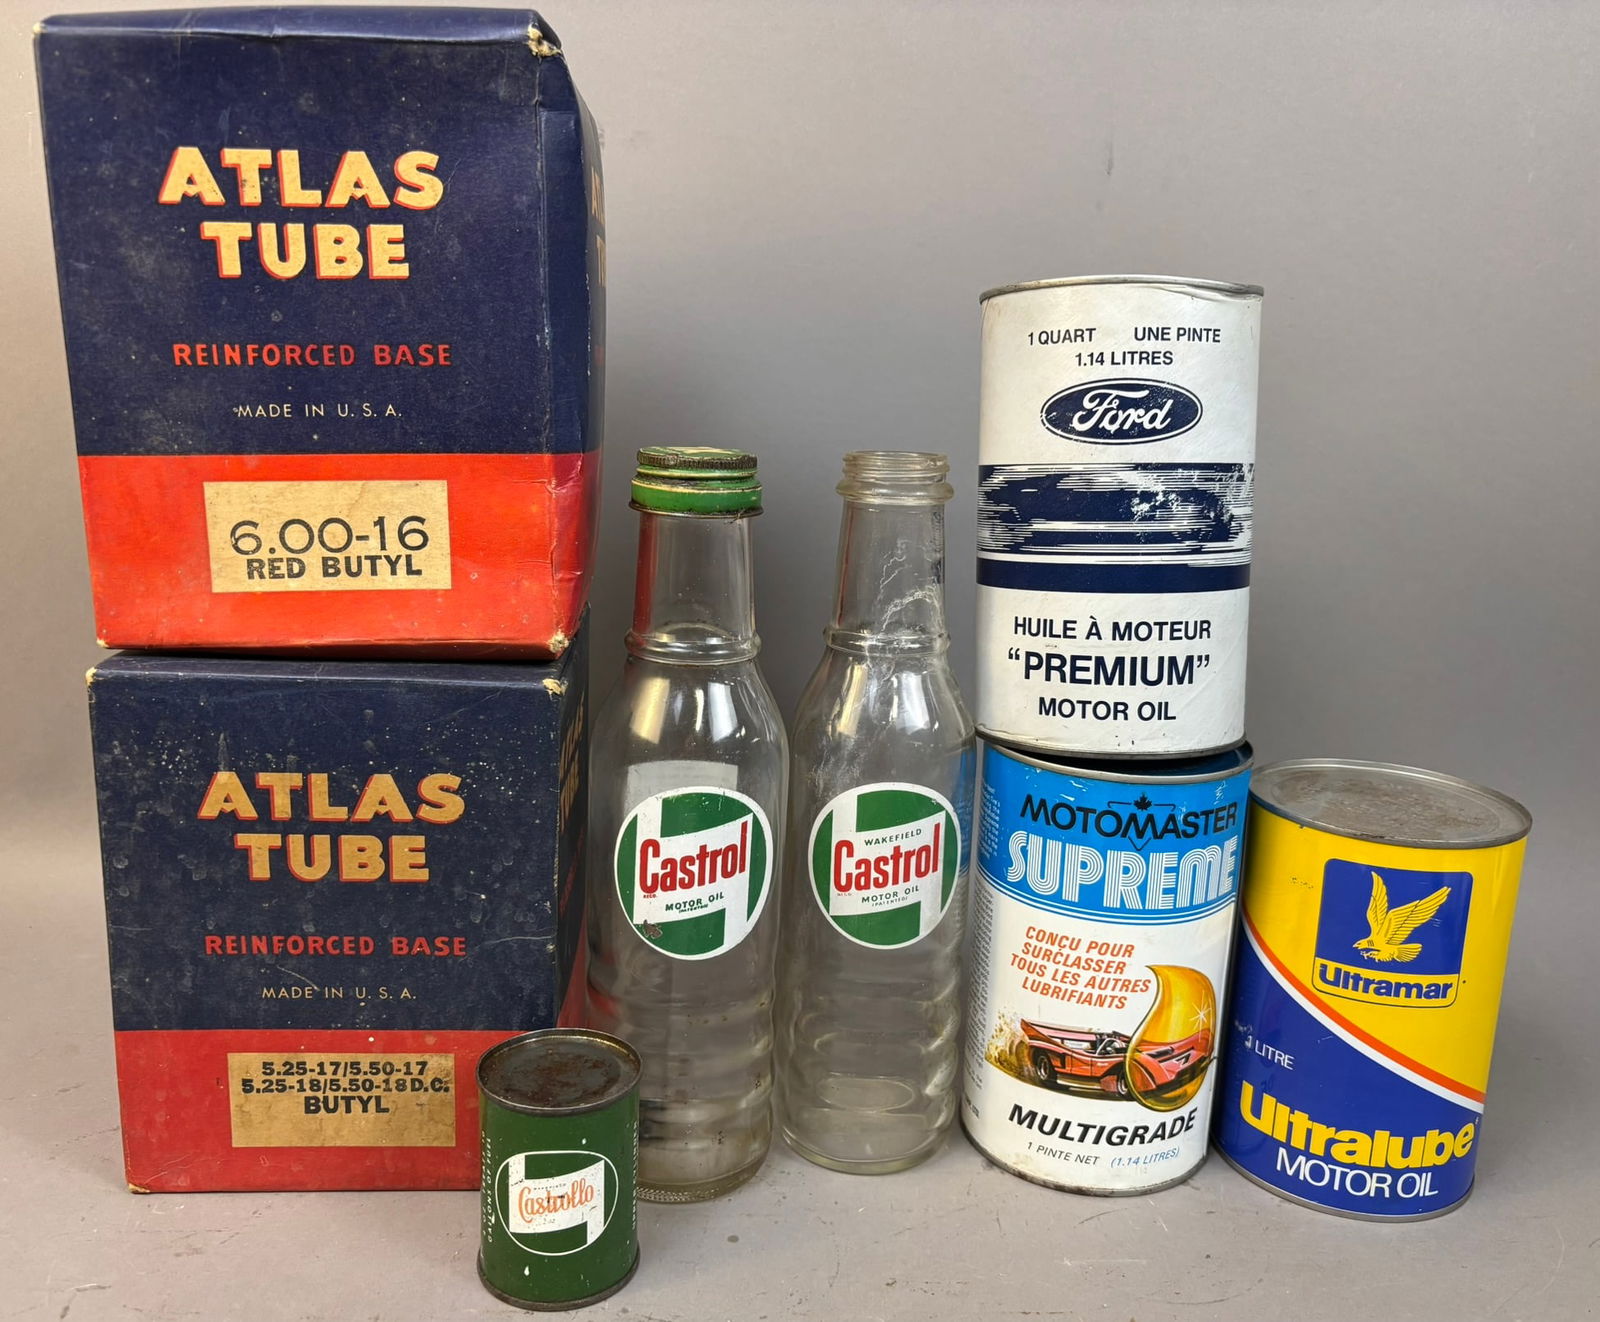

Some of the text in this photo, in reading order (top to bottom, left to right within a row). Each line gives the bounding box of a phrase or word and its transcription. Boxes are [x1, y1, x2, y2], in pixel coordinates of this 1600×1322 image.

[158, 146, 444, 210] ATLAS
[201, 221, 410, 279] TUBE
[1028, 326, 1221, 346] 1 QUART UNE PINTE
[172, 343, 452, 366] REINFORCED BASE
[1075, 350, 1173, 367] 1.14 LITRES
[237, 403, 292, 418] MADE
[305, 403, 324, 418] IN
[1071, 388, 1174, 434] Ford
[229, 516, 430, 556] 6.00-16
[246, 554, 423, 580] RED BUTYL
[1013, 615, 1211, 641] HUILE À MOTEUR
[1007, 646, 1210, 686] “PREMIUM”
[1038, 696, 1176, 721] MOTOR OIL
[197, 771, 465, 823] ATLAS
[1020, 793, 1237, 842] MOTOMASTER
[864, 828, 922, 846] WAKEFIELD
[234, 833, 429, 882] TUBE
[639, 820, 748, 894] Castrol
[834, 822, 941, 892] Castrol
[1007, 829, 1238, 910] SUPREME
[665, 892, 724, 911] MOTOR OIL
[861, 891, 898, 903] MOTOR
[904, 885, 919, 895] OIL
[205, 934, 467, 957] REINFORCED BASE
[1021, 941, 1126, 974] SURCLASSER
[1025, 926, 1135, 958] CONÇU POUR
[1010, 953, 1152, 993] TOUS LES AUTRES
[1318, 963, 1453, 1000] Ultramar
[262, 986, 314, 999] MADE
[324, 987, 343, 999] IN
[1021, 976, 1127, 1009] LUBRIFIANTS
[262, 1061, 428, 1077] 5.25-17/5.50-17
[1254, 1040, 1296, 1070] LITRE
[304, 1095, 390, 1114] BUTYL
[1008, 1103, 1198, 1146] MULTIGRADE
[1240, 1080, 1475, 1169] Ultralube
[1027, 1142, 1180, 1168] 1 PINTE NET (1.14 LITRES)
[1276, 1147, 1439, 1198] MOTOR OIL
[518, 1178, 594, 1223] Castrollo
